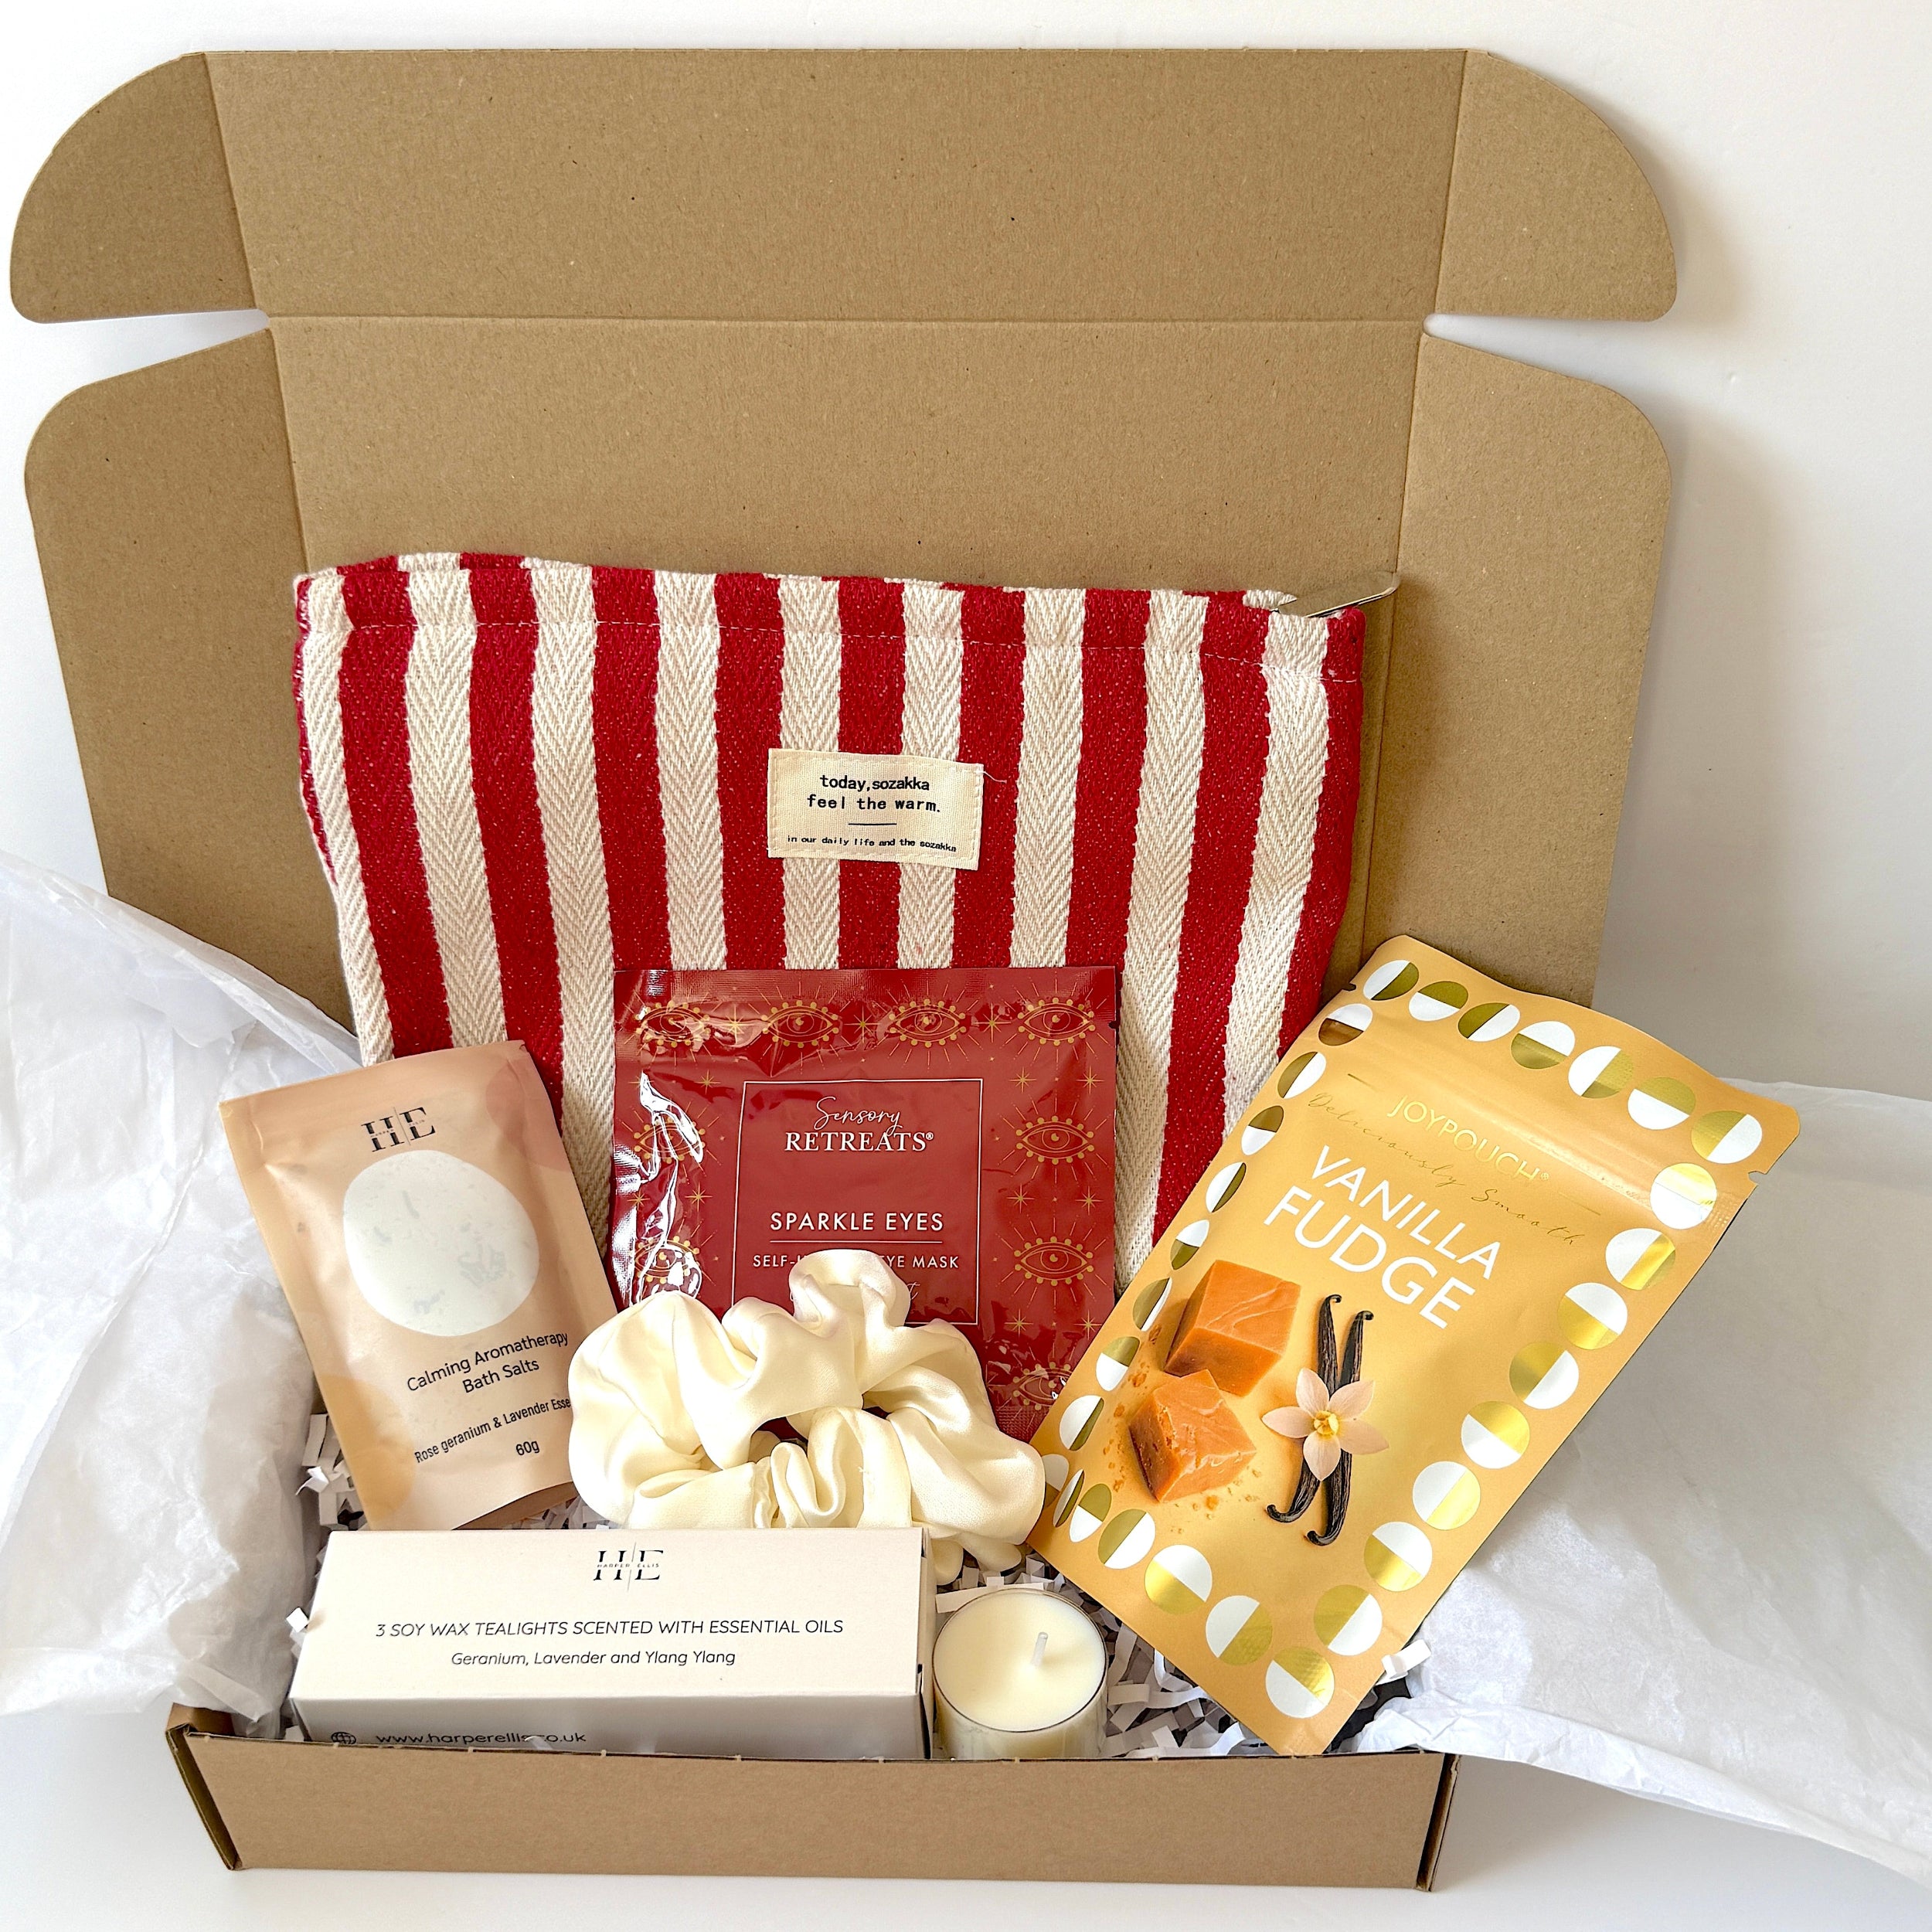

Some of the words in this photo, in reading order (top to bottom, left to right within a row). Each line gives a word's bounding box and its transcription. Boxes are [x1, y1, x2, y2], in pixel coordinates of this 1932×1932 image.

[819, 774, 930, 792] today,sozakka
[807, 794, 845, 810] feel
[856, 797, 886, 810] the
[895, 799, 941, 813] warm.
[821, 837, 849, 846] daily
[854, 838, 875, 846] life
[879, 838, 896, 846] and
[900, 838, 916, 846] the
[920, 841, 957, 852] sozakka
[814, 1095, 903, 1136] Sensory
[1308, 1091, 1466, 1188] Deliciously
[1471, 1189, 1586, 1246] Smooth
[770, 1211, 875, 1232] SPARKLE
[886, 1212, 944, 1232] EYES
[1311, 1145, 1502, 1280] VANILLA
[879, 1254, 905, 1268] YE
[912, 1255, 960, 1269] MASK
[1264, 1185, 1475, 1329] FUDGE
[406, 1358, 471, 1392] Calming
[474, 1332, 570, 1366] Aromatherapy
[462, 1370, 501, 1393] Bath
[502, 1359, 540, 1379] Salts
[414, 1444, 440, 1464] Rose
[440, 1422, 492, 1454] geranium
[493, 1417, 503, 1429] &
[503, 1401, 549, 1425] Lavender
[515, 1440, 540, 1457] 60g
[376, 1624, 386, 1638] 3
[389, 1623, 426, 1637] SOY
[430, 1623, 471, 1636] WAX
[475, 1621, 568, 1636] TEALIGHTS
[573, 1621, 654, 1635] SCENTED
[658, 1620, 704, 1634] WITH
[709, 1620, 801, 1634] ESSENTIAL
[804, 1619, 844, 1634] OILS
[451, 1651, 530, 1667] Geranium,
[534, 1651, 607, 1665] Lavender
[610, 1651, 641, 1665] and
[645, 1651, 688, 1667] Ylang
[692, 1650, 736, 1666] Ylang
[376, 1732, 587, 1746] www.harperelliso.uk
